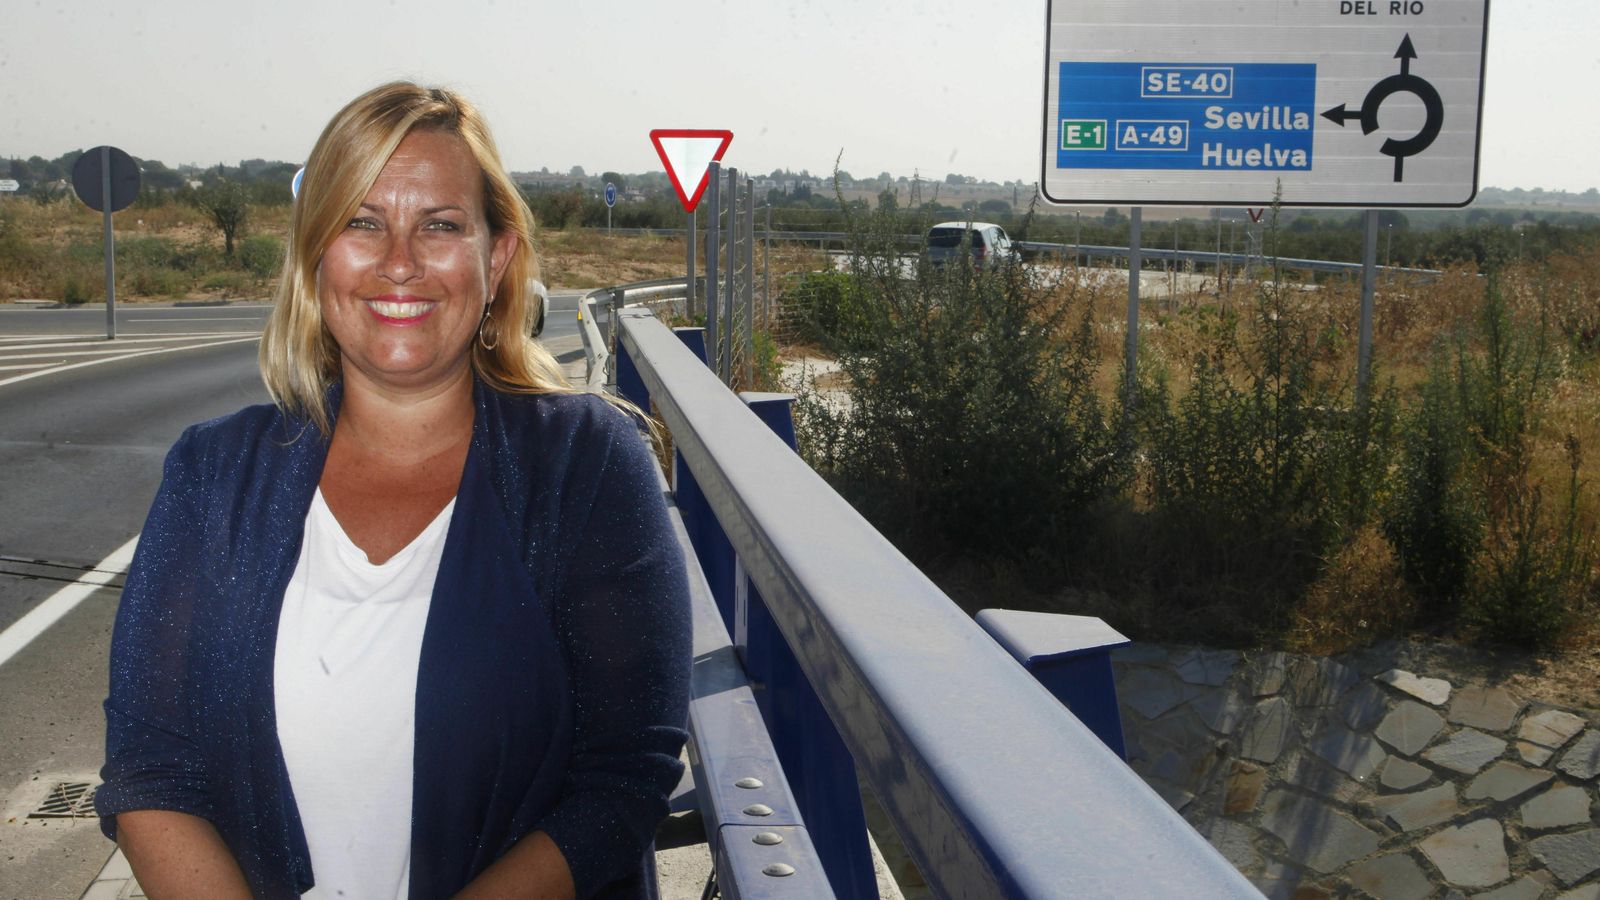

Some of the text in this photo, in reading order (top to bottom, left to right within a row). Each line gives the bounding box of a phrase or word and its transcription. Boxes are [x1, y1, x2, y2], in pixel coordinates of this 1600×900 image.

[1340, 0, 1378, 15] DEL
[1147, 72, 1228, 93] SE-40
[1203, 105, 1310, 130] Sevilla
[1066, 124, 1183, 146] E-1 A-49
[1201, 142, 1308, 167] Huelva
